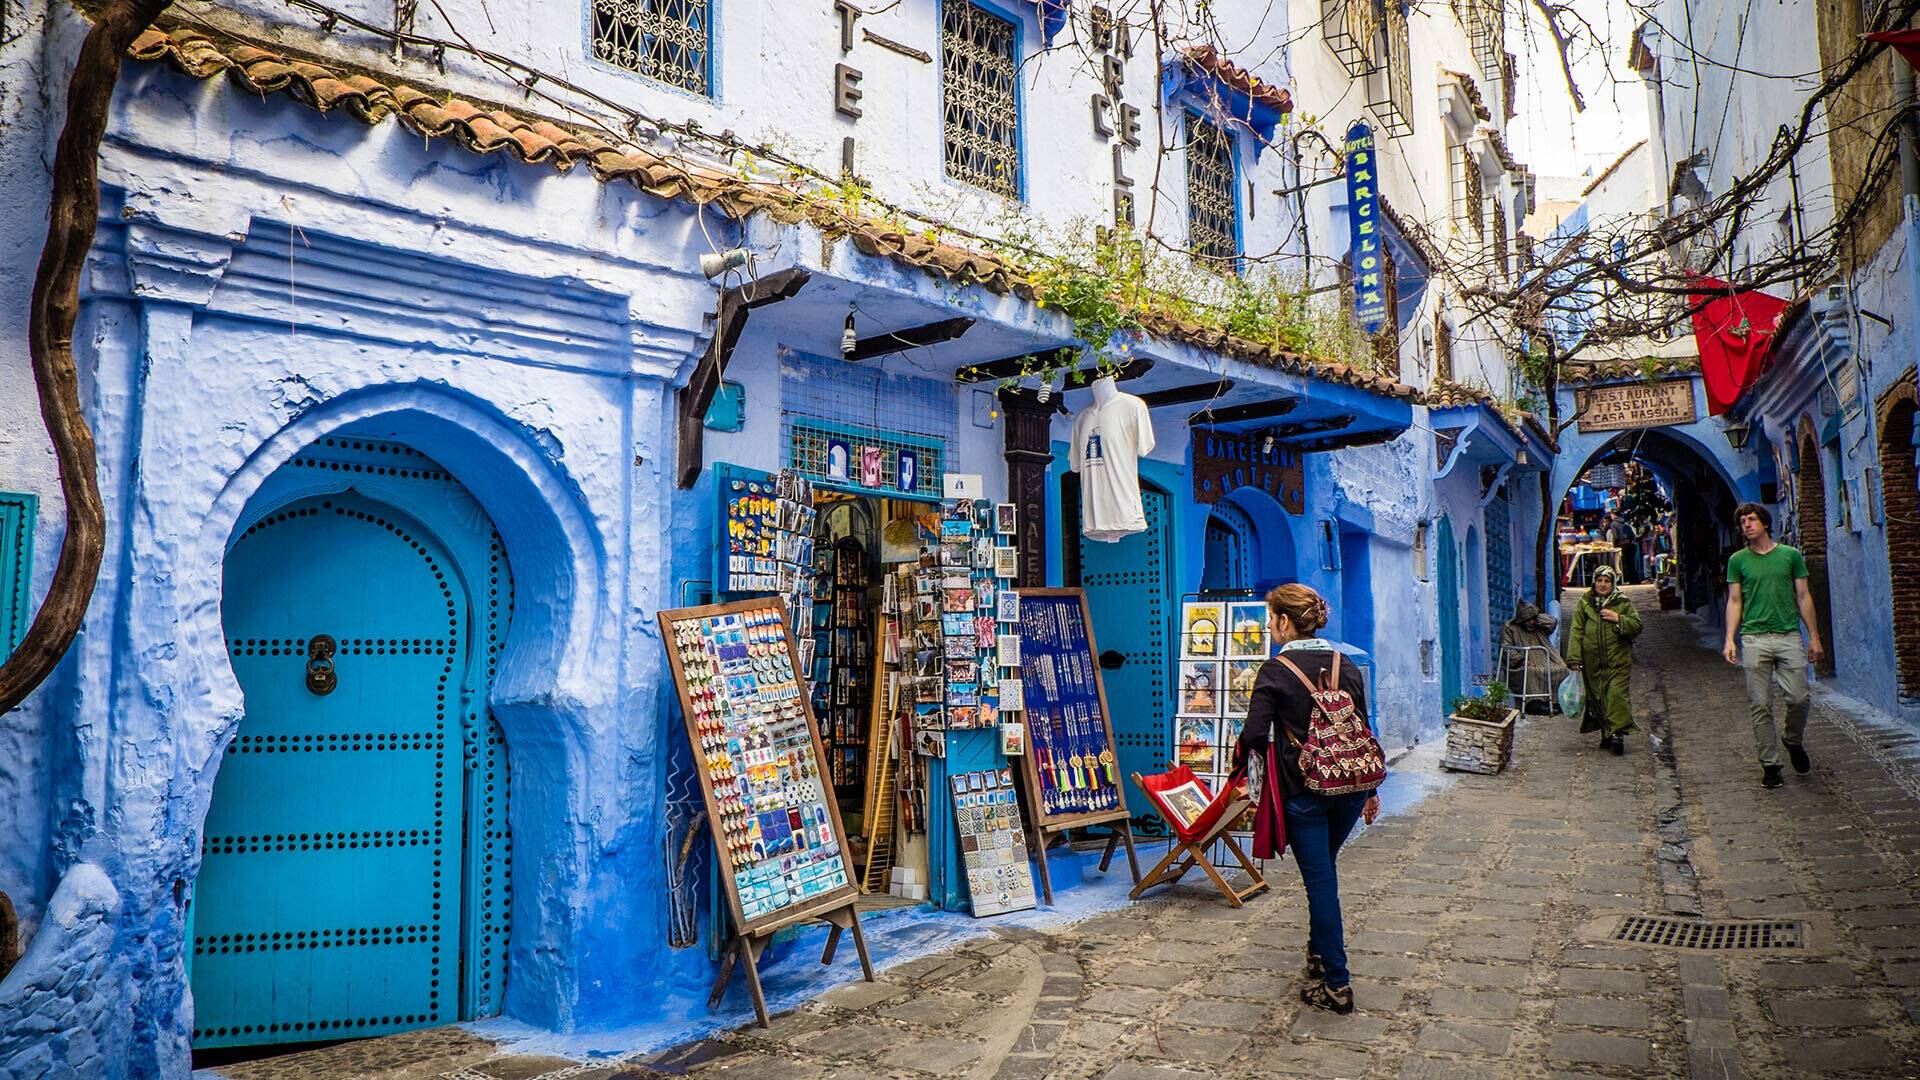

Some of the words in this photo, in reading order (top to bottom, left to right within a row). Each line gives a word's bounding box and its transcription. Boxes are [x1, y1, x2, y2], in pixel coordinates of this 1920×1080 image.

[1091, 6, 1142, 248] BARCELO
[1346, 136, 1373, 152] HOTEL
[1354, 152, 1381, 304] BARCELONA
[1591, 386, 1677, 404] RESTAURANT
[1594, 412, 1625, 423] CASA
[1206, 438, 1296, 468] BARCELONA
[1221, 466, 1285, 501] HOTEL
